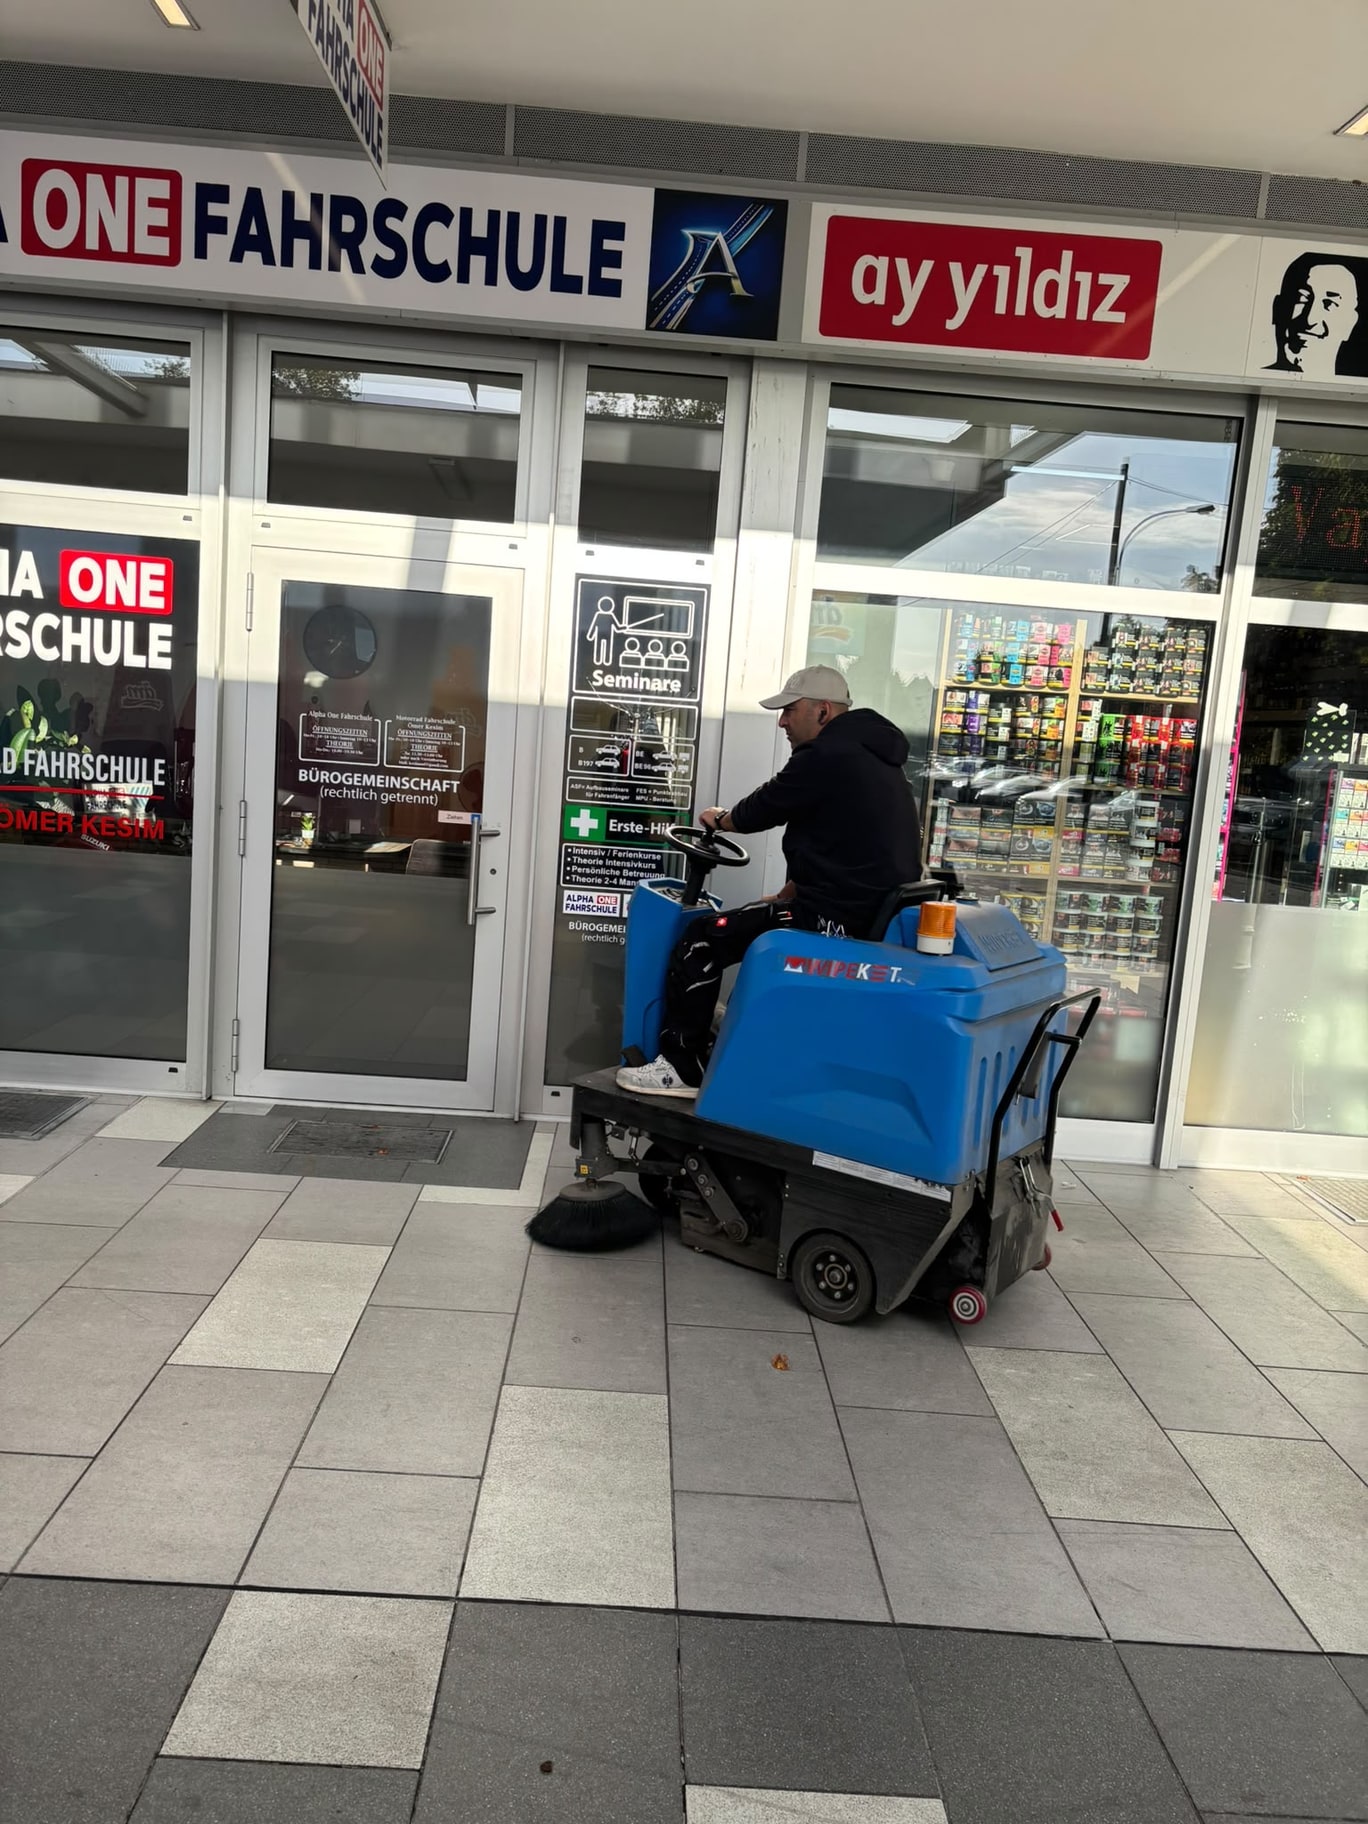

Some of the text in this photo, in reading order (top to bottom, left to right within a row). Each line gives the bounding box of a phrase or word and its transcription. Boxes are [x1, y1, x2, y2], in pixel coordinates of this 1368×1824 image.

[359, 6, 383, 96] ONE
[32, 167, 626, 299] ONE FAHRSCHULE
[851, 246, 1132, 331] ay yıldız
[1290, 485, 1364, 549] Va
[67, 556, 167, 610] ONE
[591, 669, 682, 693] Seminare
[308, 710, 326, 719] Alpha
[340, 712, 373, 722] Fahrschule
[424, 717, 456, 725] Fahrschule
[312, 724, 368, 736] ÖFFNUNGSZEITEN
[397, 728, 453, 738] ÖFFNUNGSZEITEN
[326, 740, 354, 748] THEORIE
[410, 743, 438, 751] THEORIE
[24, 748, 166, 786] FAHRSCHULE
[298, 767, 461, 794] BÜROGEMEINSCHAFT
[320, 785, 439, 807] (rechtlich getrennt)
[0, 802, 165, 841] ÖMER KESIM
[572, 847, 605, 857] Intensiv
[612, 849, 662, 860] Ferienkurse
[572, 856, 657, 870] Theorie Intensivkurs
[571, 865, 621, 877] Persönliche
[571, 874, 638, 888] Theorie 2-4 Man
[566, 894, 618, 905] ALPHA ONE
[565, 903, 617, 914] FAHRSCHULE
[568, 919, 626, 933] BÜROGEMEI
[581, 933, 618, 944] (rechtlich
